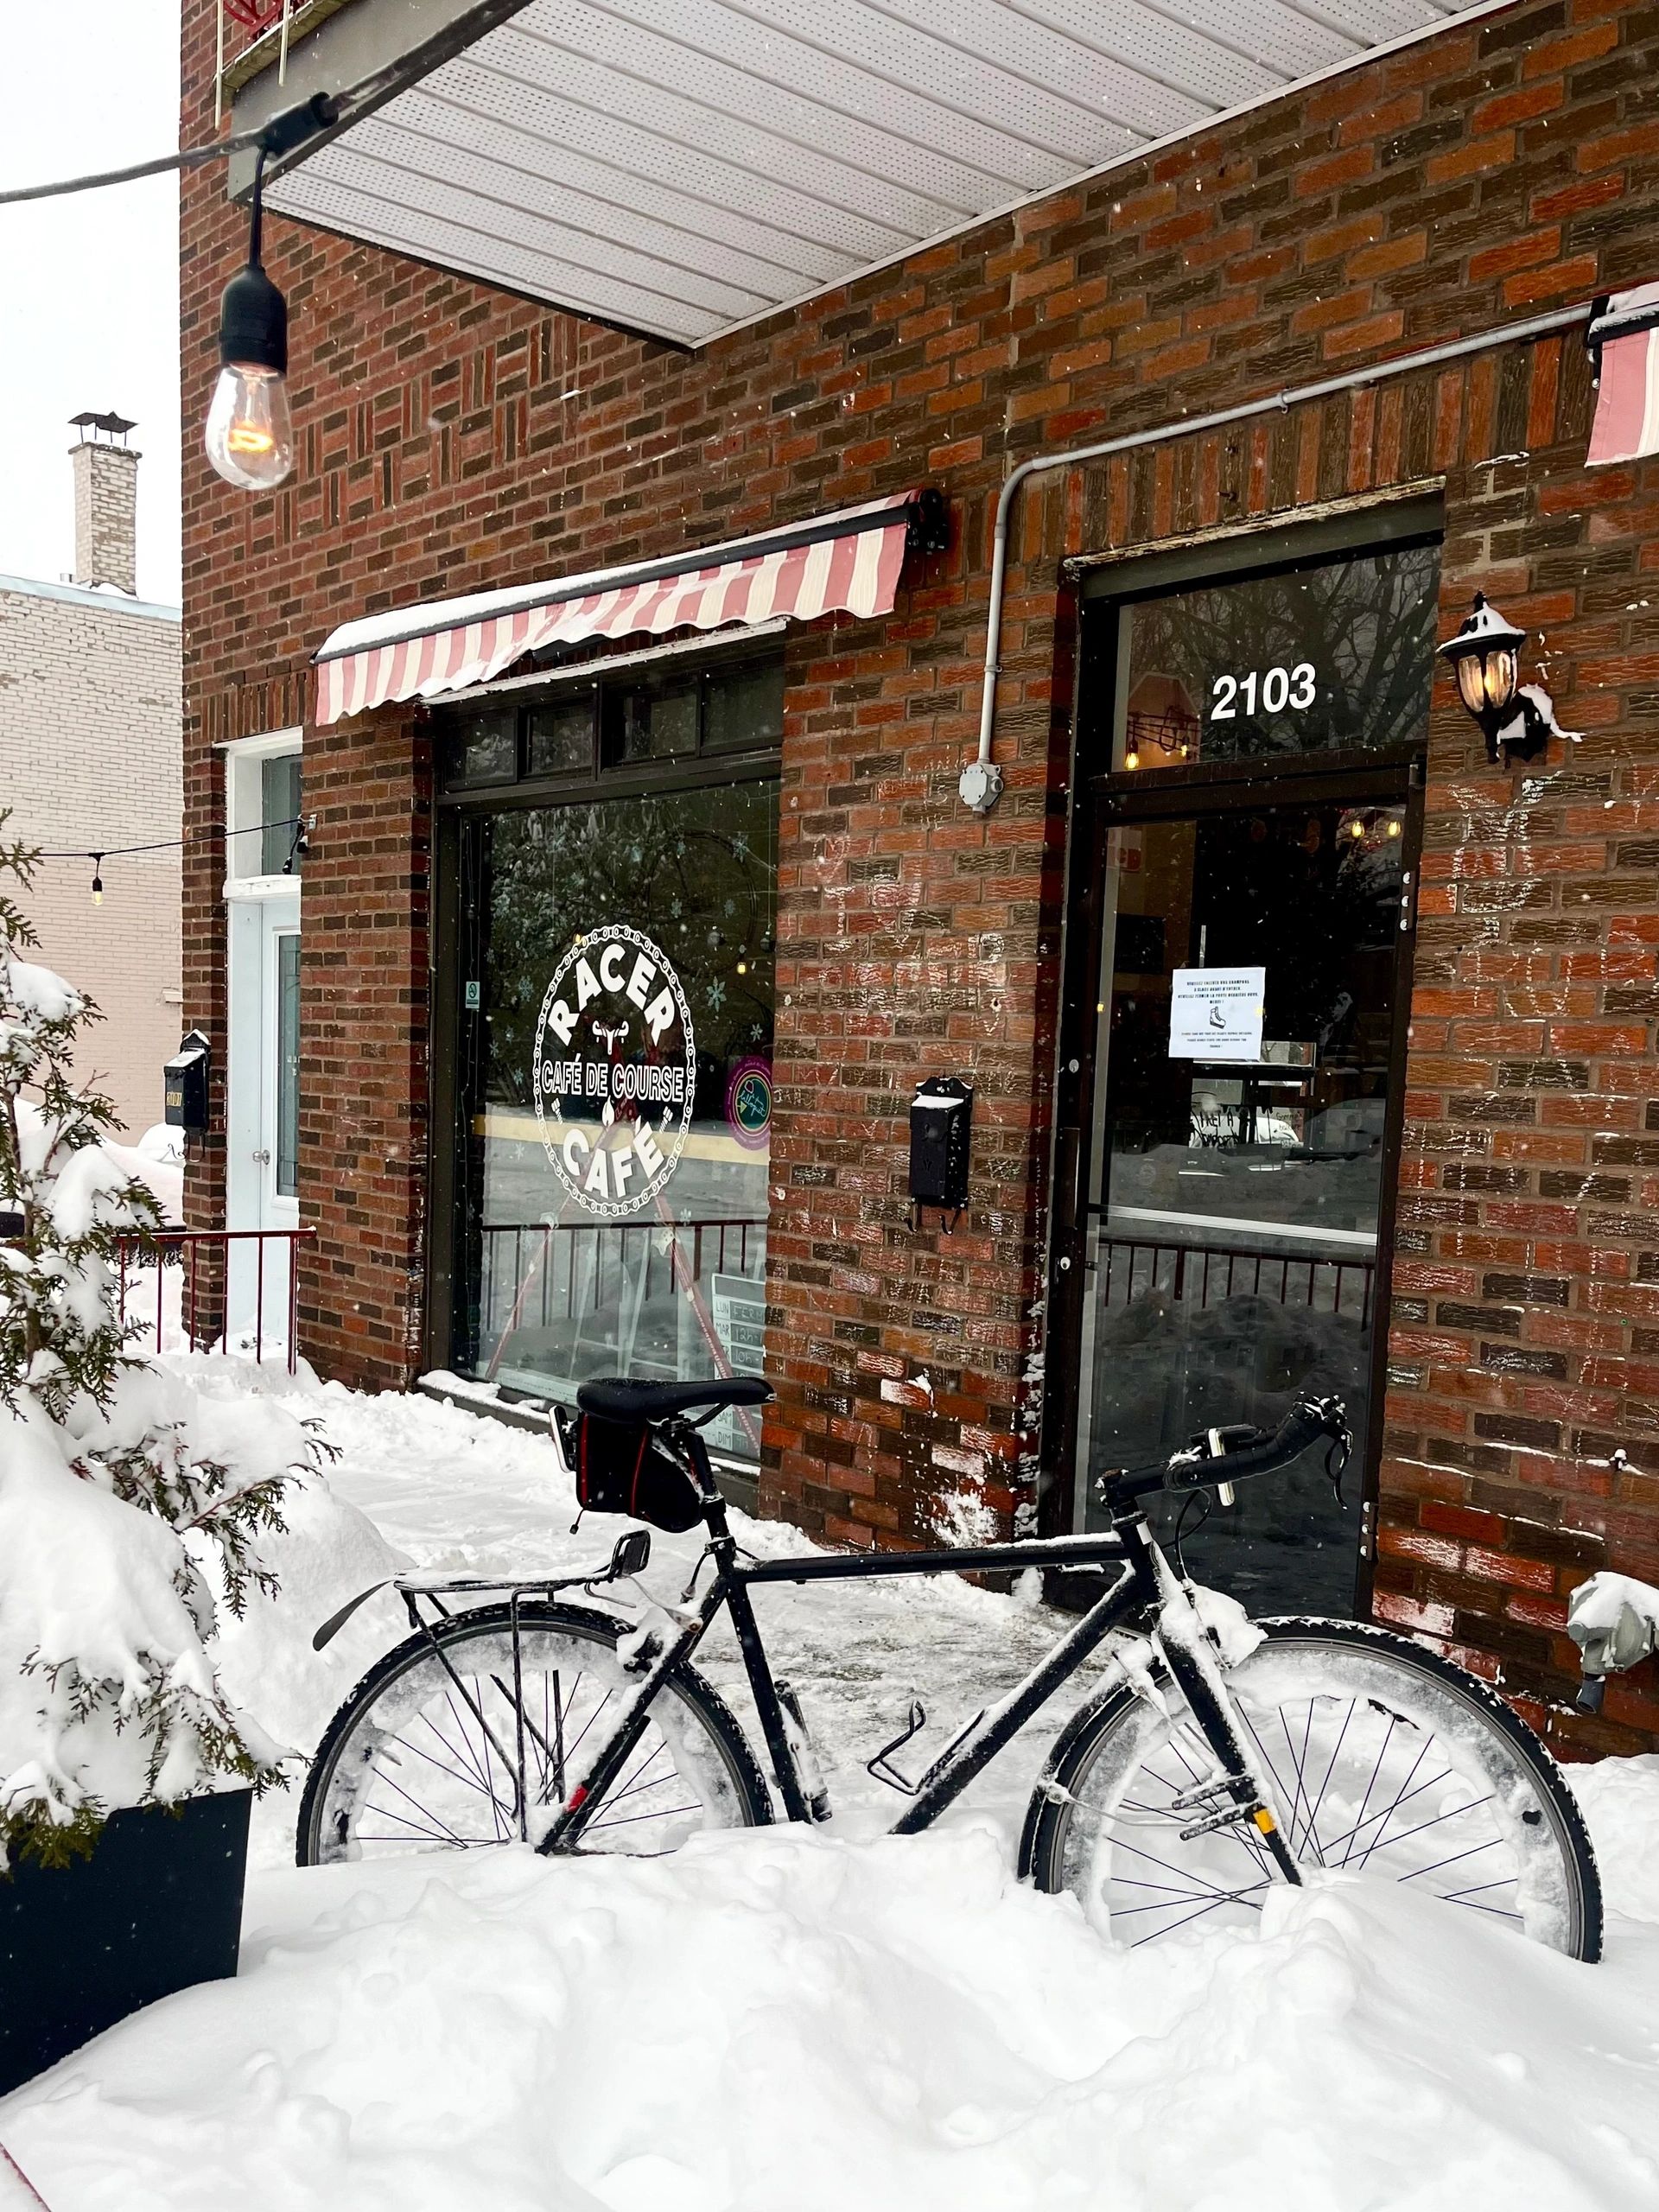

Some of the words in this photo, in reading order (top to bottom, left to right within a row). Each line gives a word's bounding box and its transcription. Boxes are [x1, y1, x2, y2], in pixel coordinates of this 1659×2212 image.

[1211, 663, 1316, 721] 2103
[548, 944, 675, 1046] RACER
[542, 1053, 582, 1096] CAFÉ
[586, 1062, 608, 1097] DE
[612, 1065, 683, 1103] COURSE
[563, 1115, 664, 1199] CAFÉ
